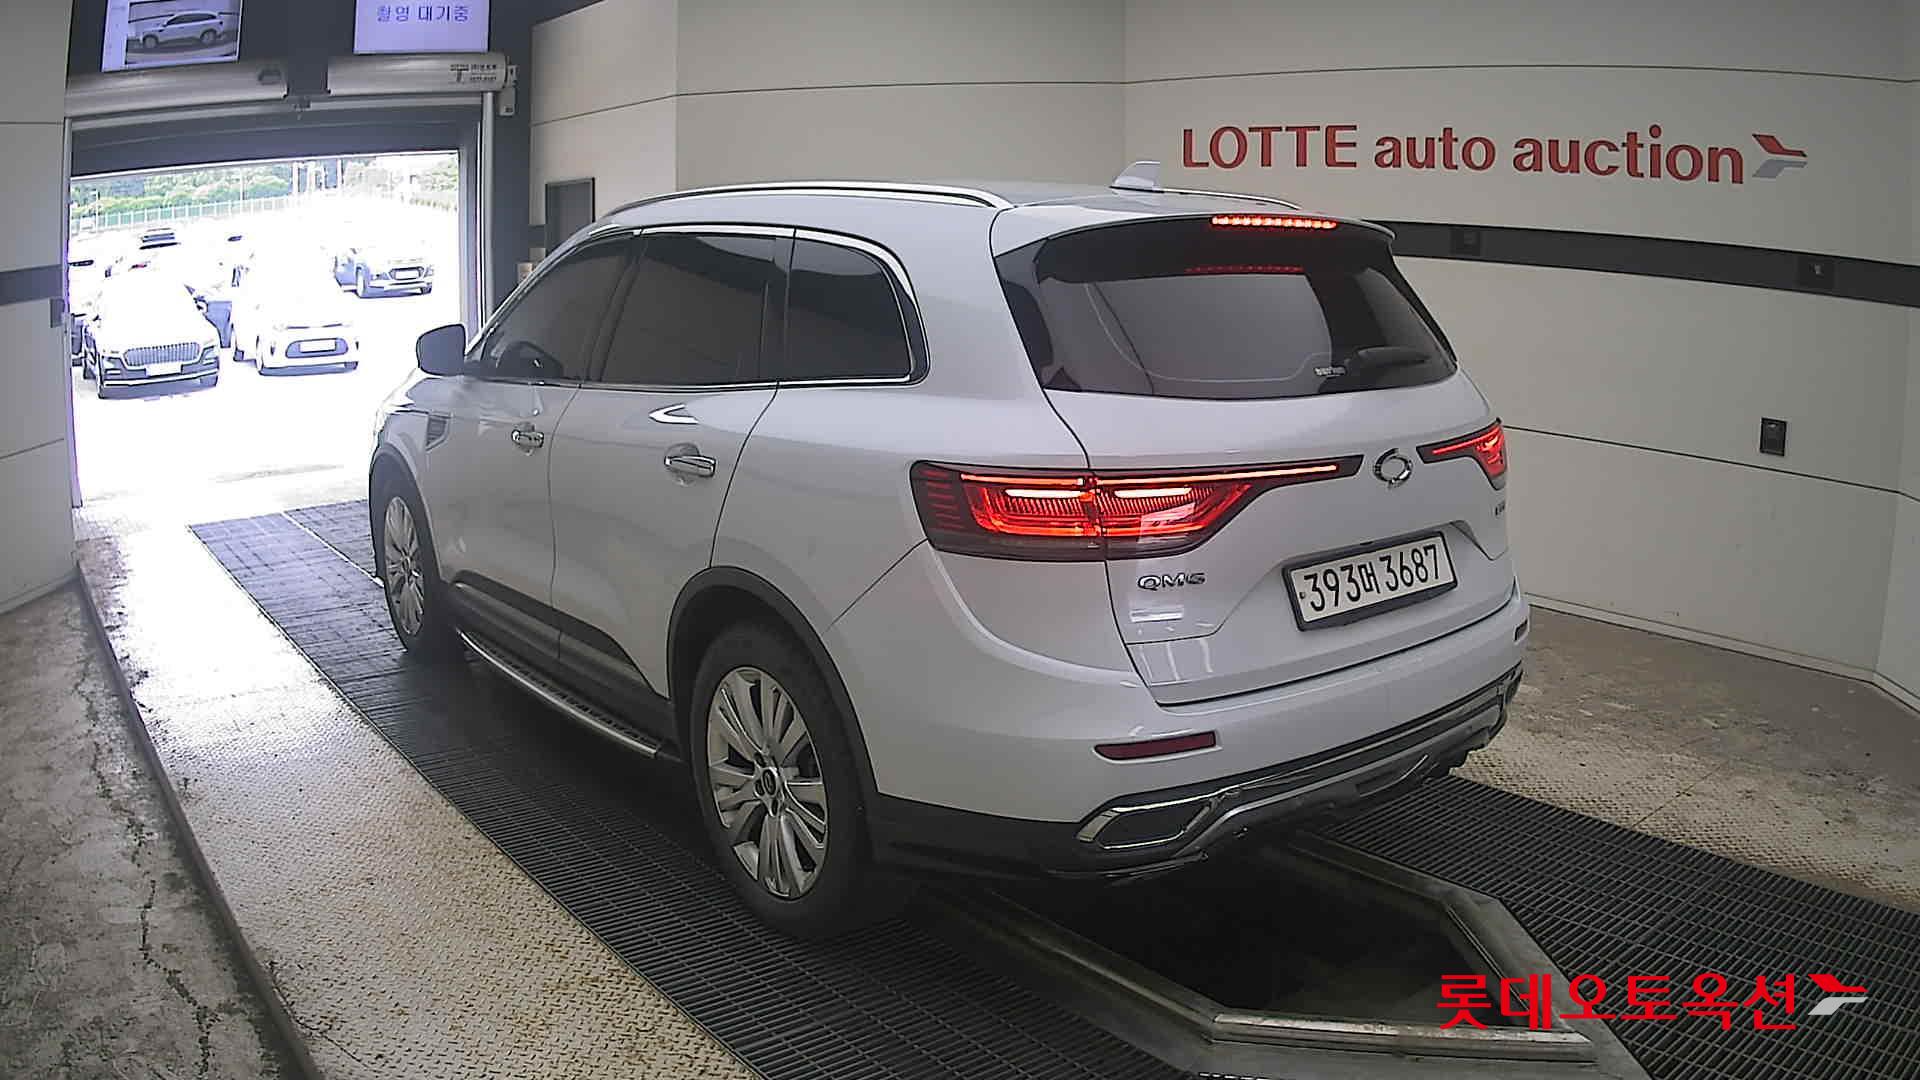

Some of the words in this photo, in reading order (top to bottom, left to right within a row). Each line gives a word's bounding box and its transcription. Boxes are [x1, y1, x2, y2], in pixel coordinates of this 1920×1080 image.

[418, 5, 470, 24] 대기중
[1183, 125, 1357, 168] LOTTE
[1375, 127, 1495, 170] auto
[1513, 125, 1743, 184] auction
[1379, 543, 1440, 592] 3687
